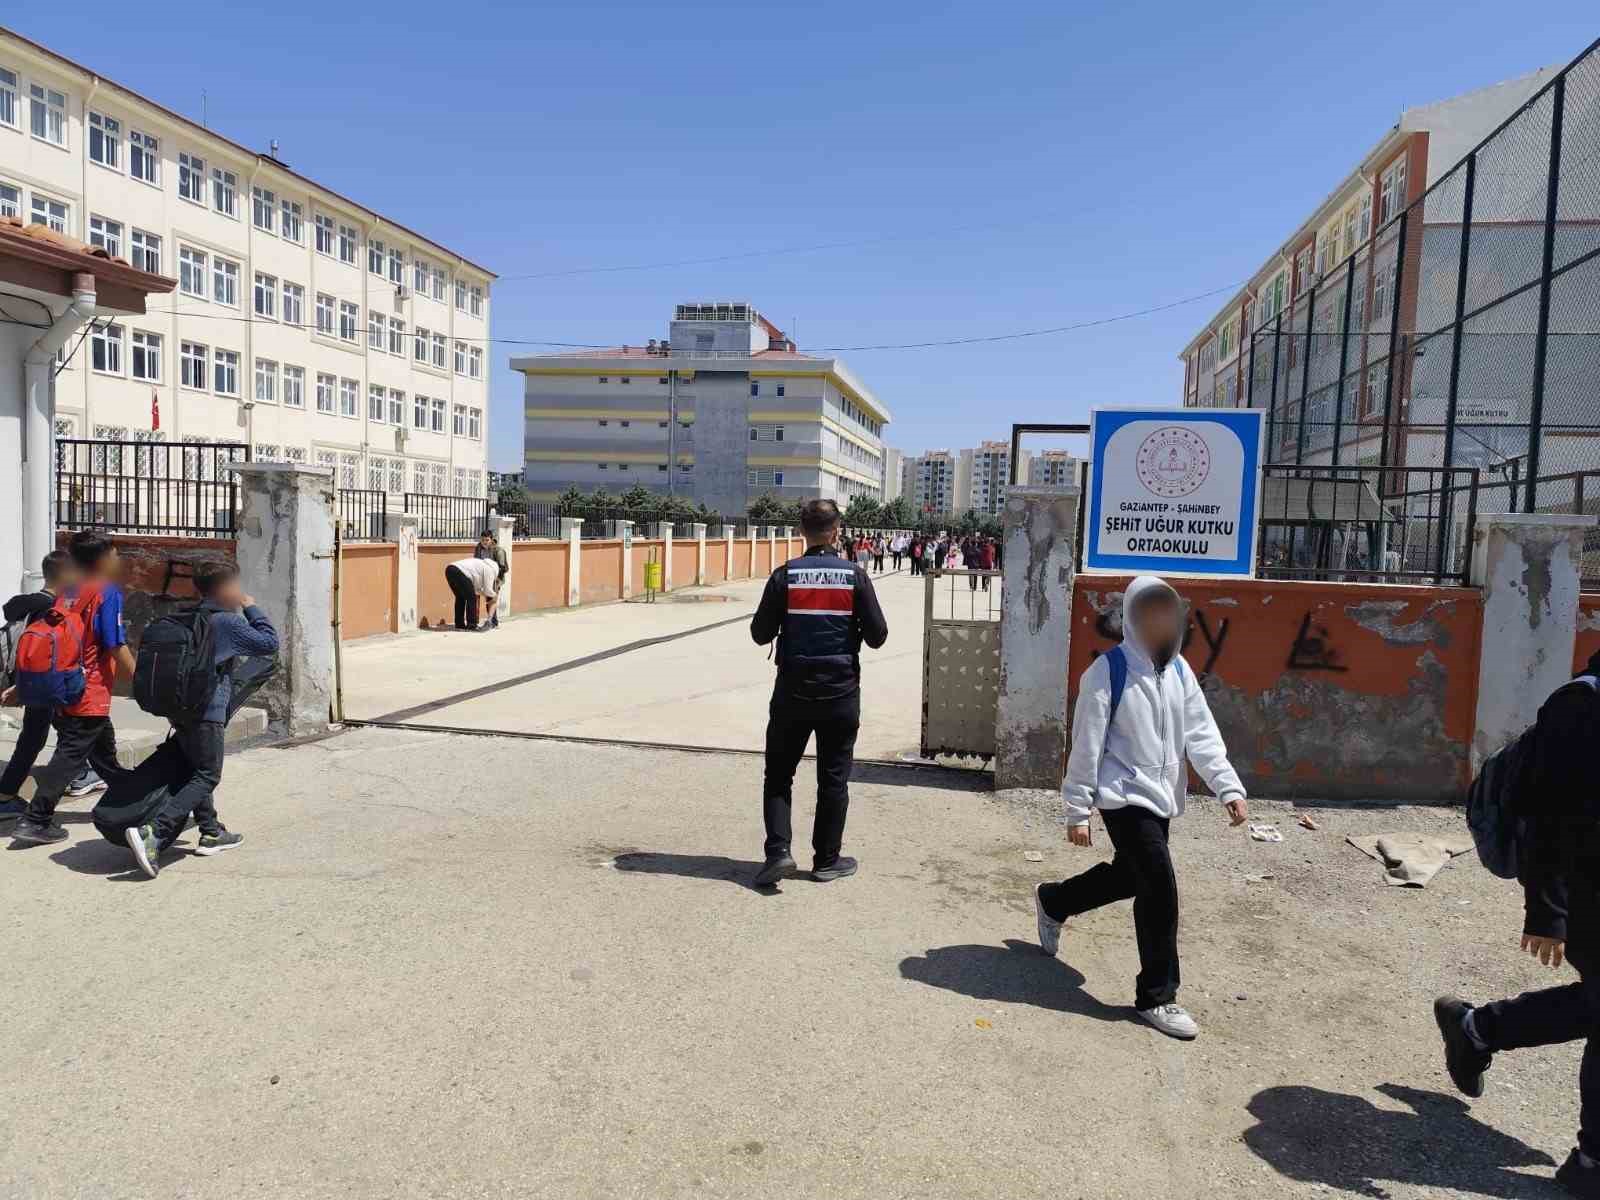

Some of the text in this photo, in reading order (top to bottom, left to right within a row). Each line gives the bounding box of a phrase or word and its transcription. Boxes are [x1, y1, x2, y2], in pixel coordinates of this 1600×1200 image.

[1145, 514, 1184, 534] UĞUR
[1187, 519, 1234, 536] KUTKU
[1127, 537, 1209, 555] ORTAOKULU
[795, 571, 848, 584] JANDARMA
